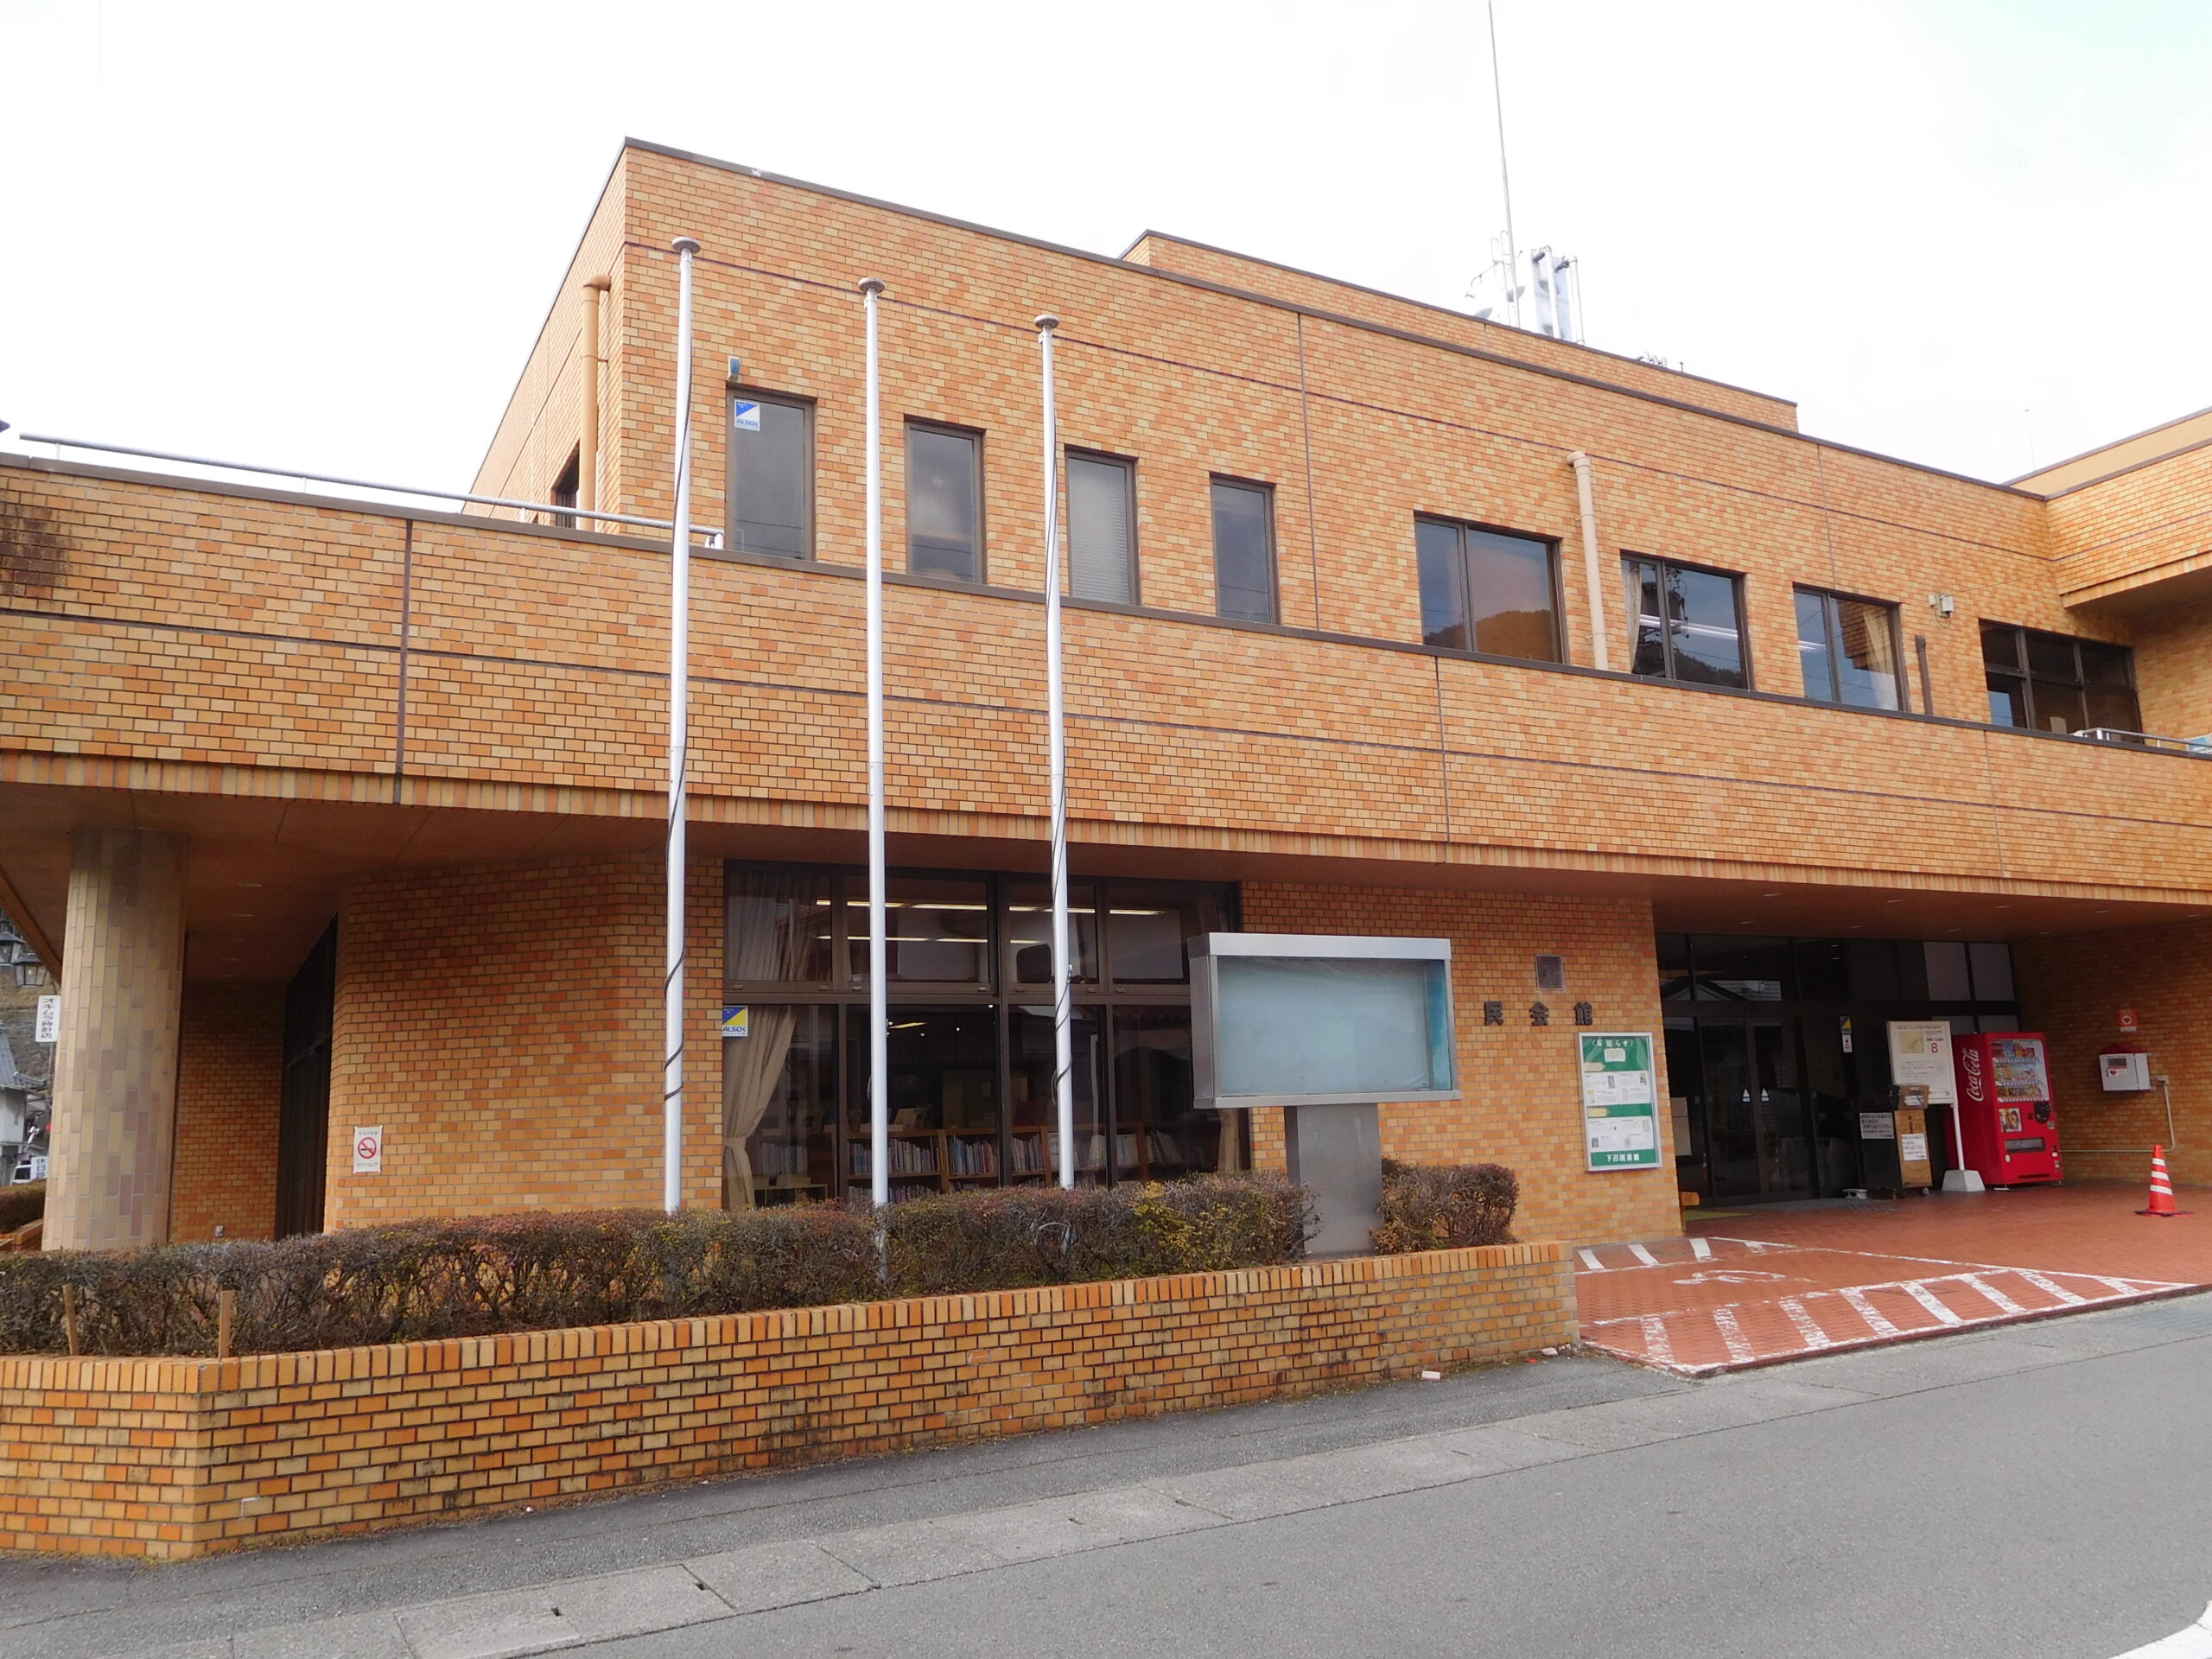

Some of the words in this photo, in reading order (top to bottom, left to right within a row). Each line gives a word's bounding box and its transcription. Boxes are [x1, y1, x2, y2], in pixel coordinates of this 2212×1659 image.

[41, 998, 54, 1038] オキムラ時計店
[1484, 1001, 1592, 1026] 民会館
[1961, 1046, 1984, 1102] Coca-Cola
